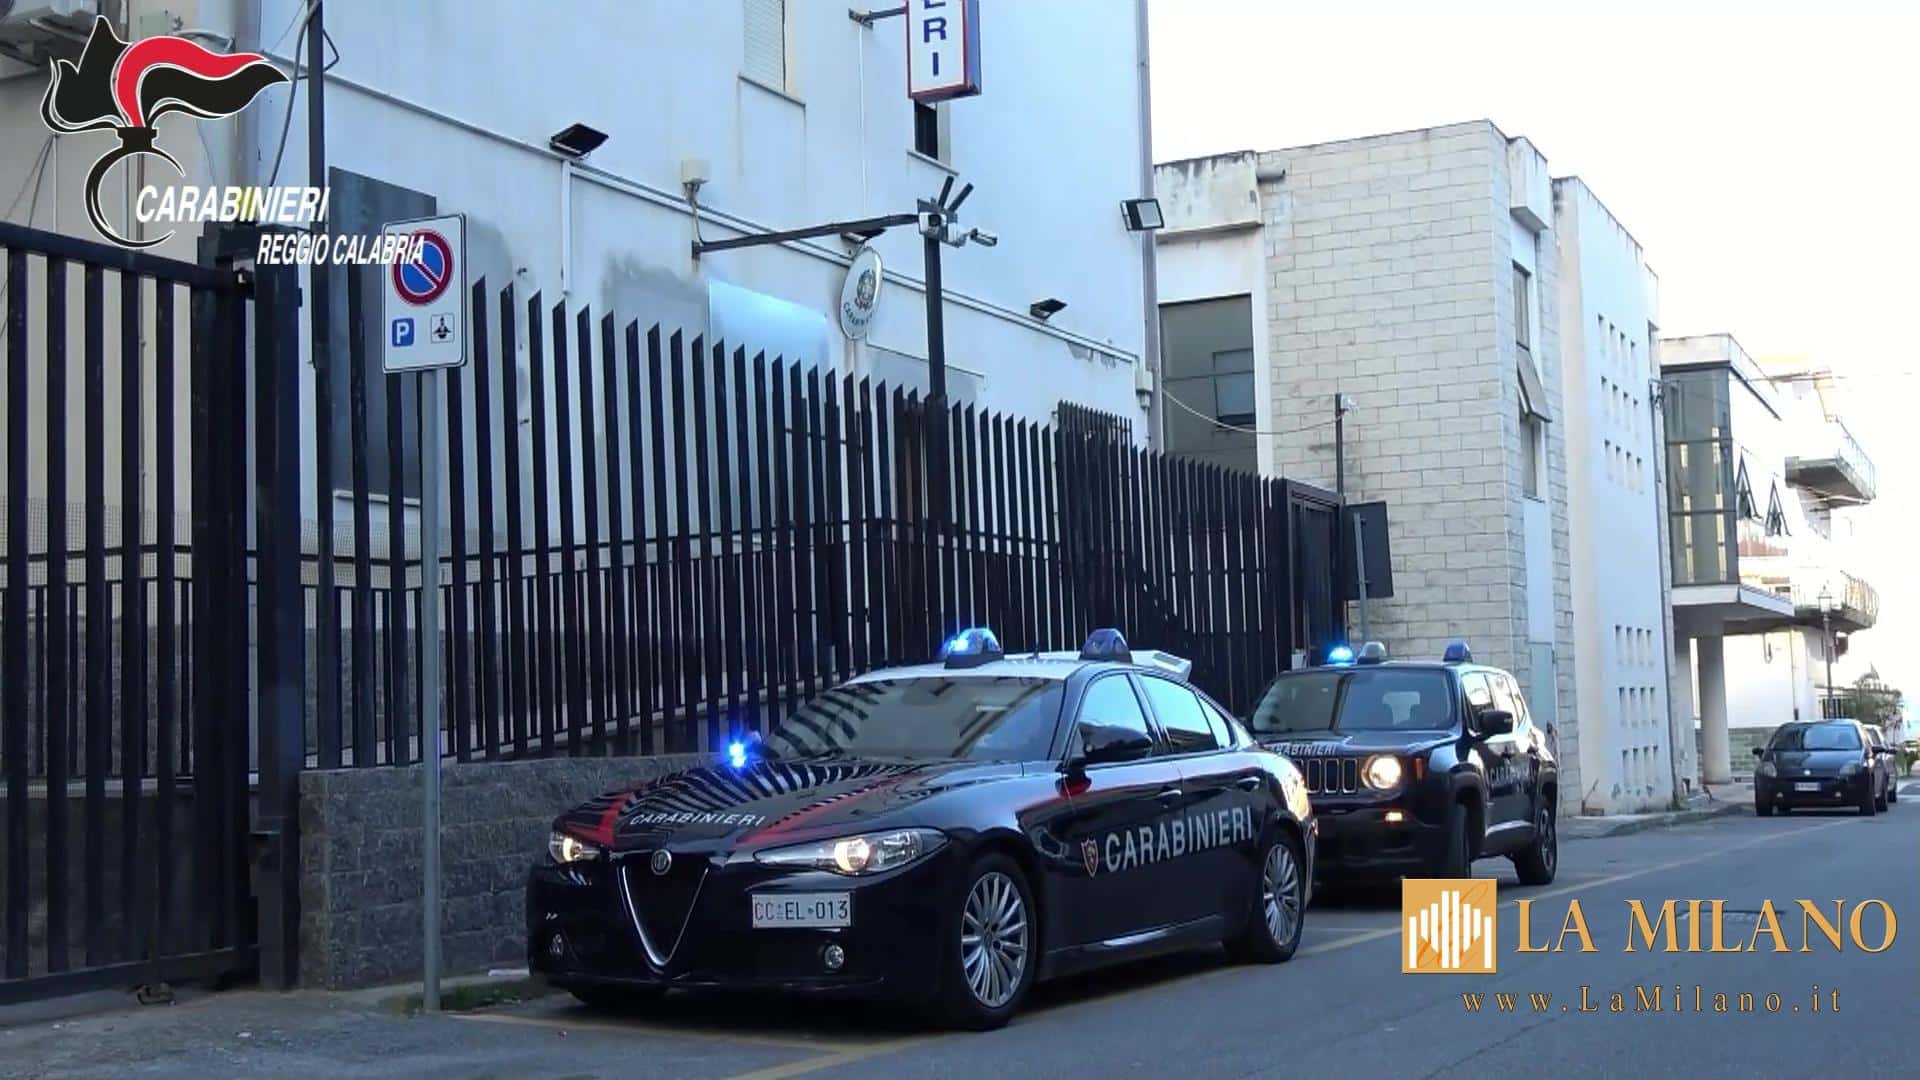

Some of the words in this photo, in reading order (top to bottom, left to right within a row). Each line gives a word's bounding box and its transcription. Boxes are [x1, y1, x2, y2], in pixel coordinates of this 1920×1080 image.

[396, 321, 410, 345] P
[629, 811, 766, 827] CARABINIERI
[1105, 805, 1252, 873] CARABINIERI
[816, 900, 848, 919] 013
